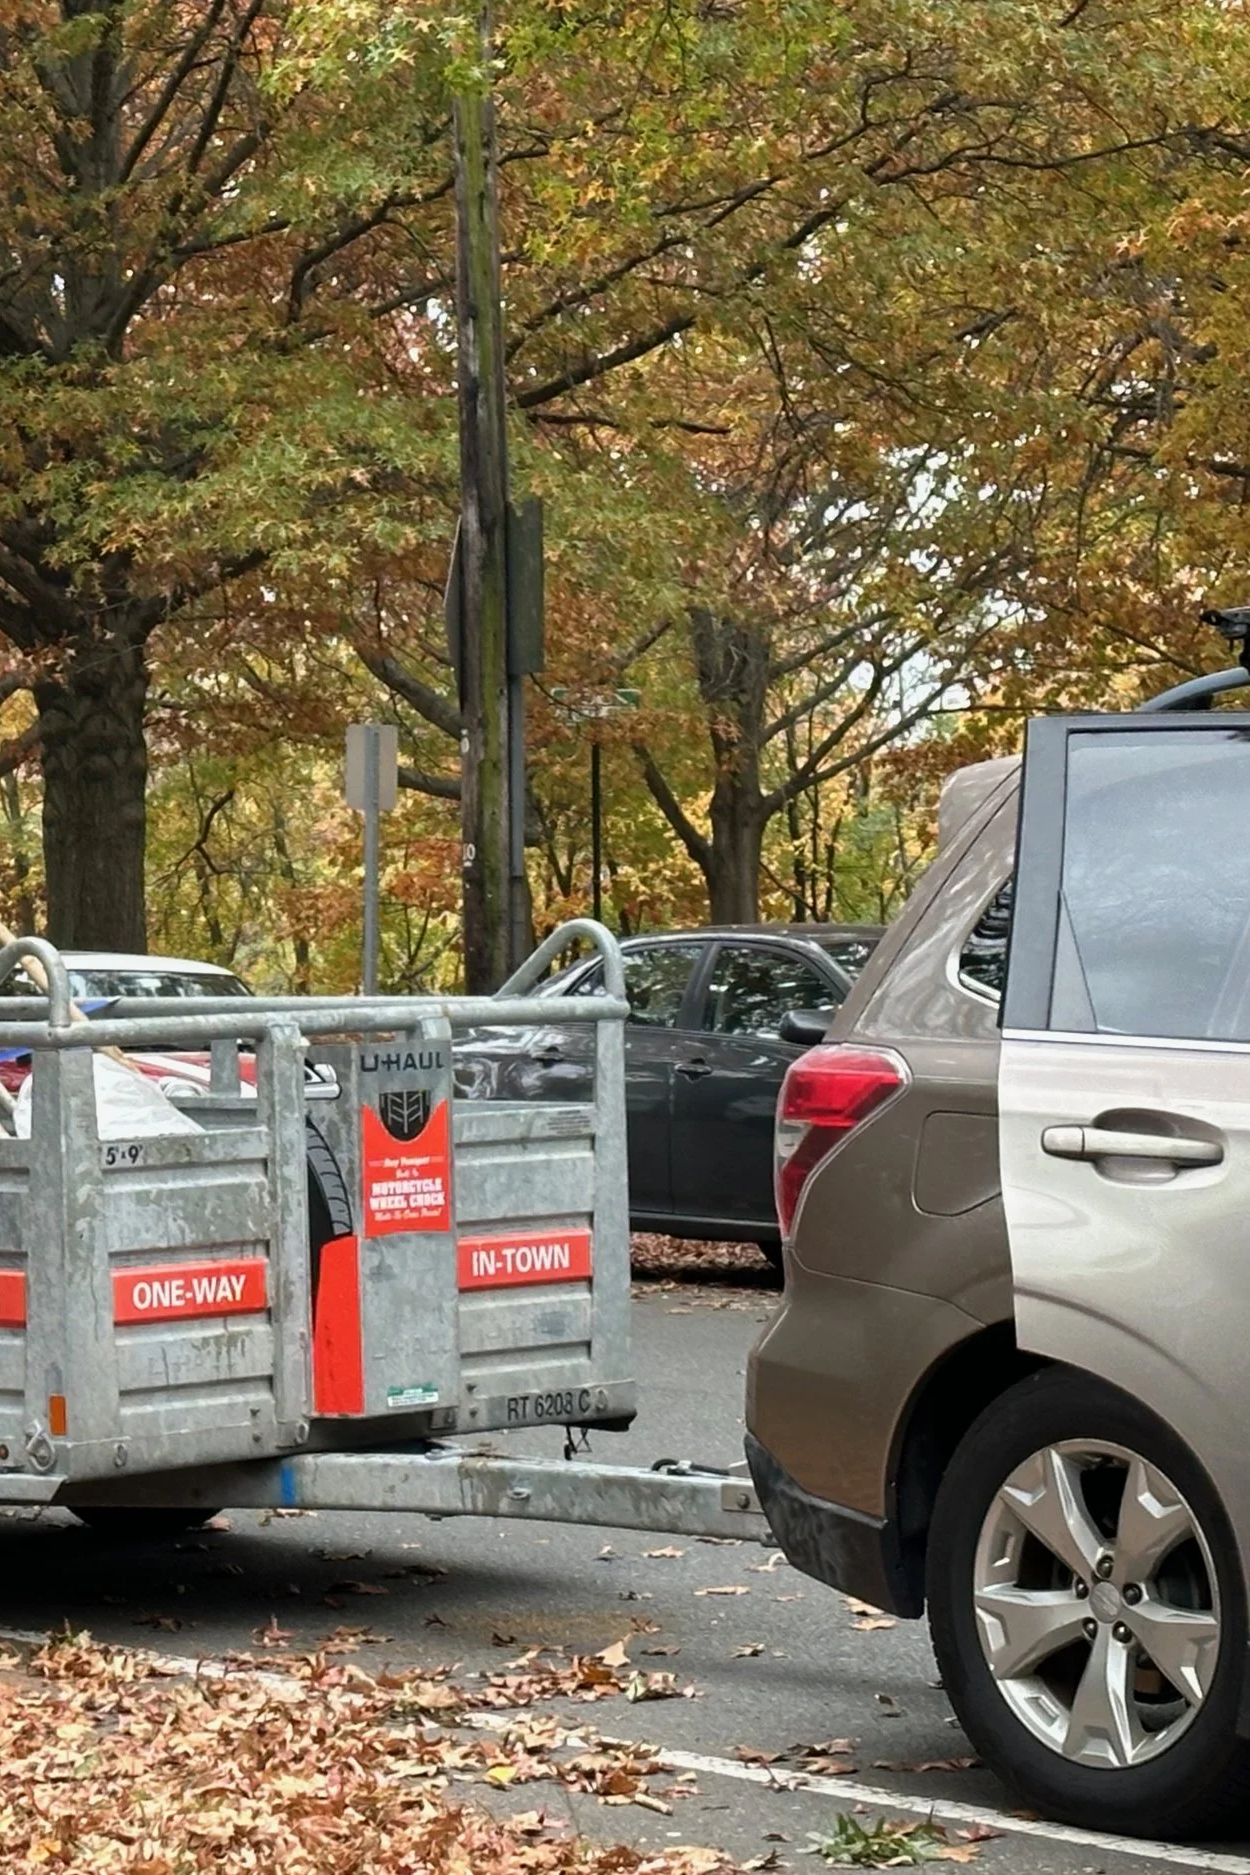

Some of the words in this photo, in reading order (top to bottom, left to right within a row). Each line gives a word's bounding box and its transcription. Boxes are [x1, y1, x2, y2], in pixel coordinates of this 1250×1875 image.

[360, 1051, 444, 1072] U-HAUL
[472, 1243, 570, 1277] IN-TOWN
[132, 1274, 246, 1311] ONE-WAY
[508, 1396, 530, 1421] RT
[579, 1389, 591, 1413] C
